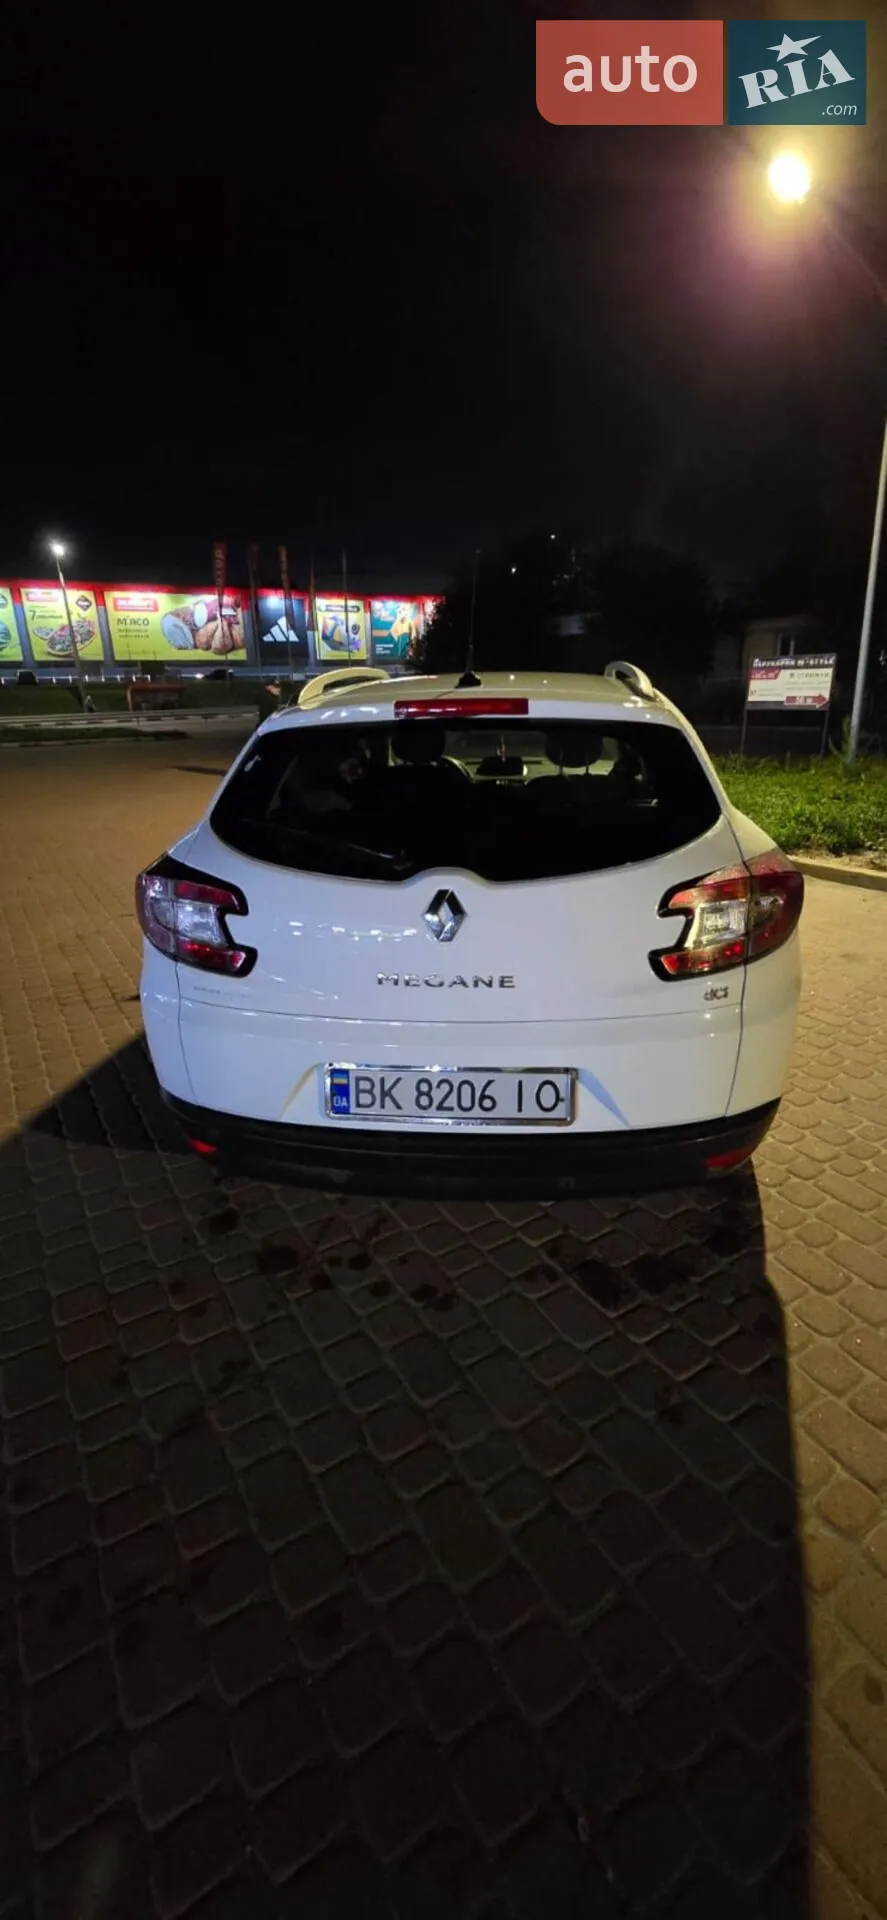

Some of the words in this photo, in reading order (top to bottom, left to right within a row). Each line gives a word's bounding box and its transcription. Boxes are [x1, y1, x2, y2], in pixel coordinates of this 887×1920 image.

[376, 972, 516, 988] MEGANE
[354, 1076, 403, 1110] BK
[414, 1078, 498, 1113] 8206
